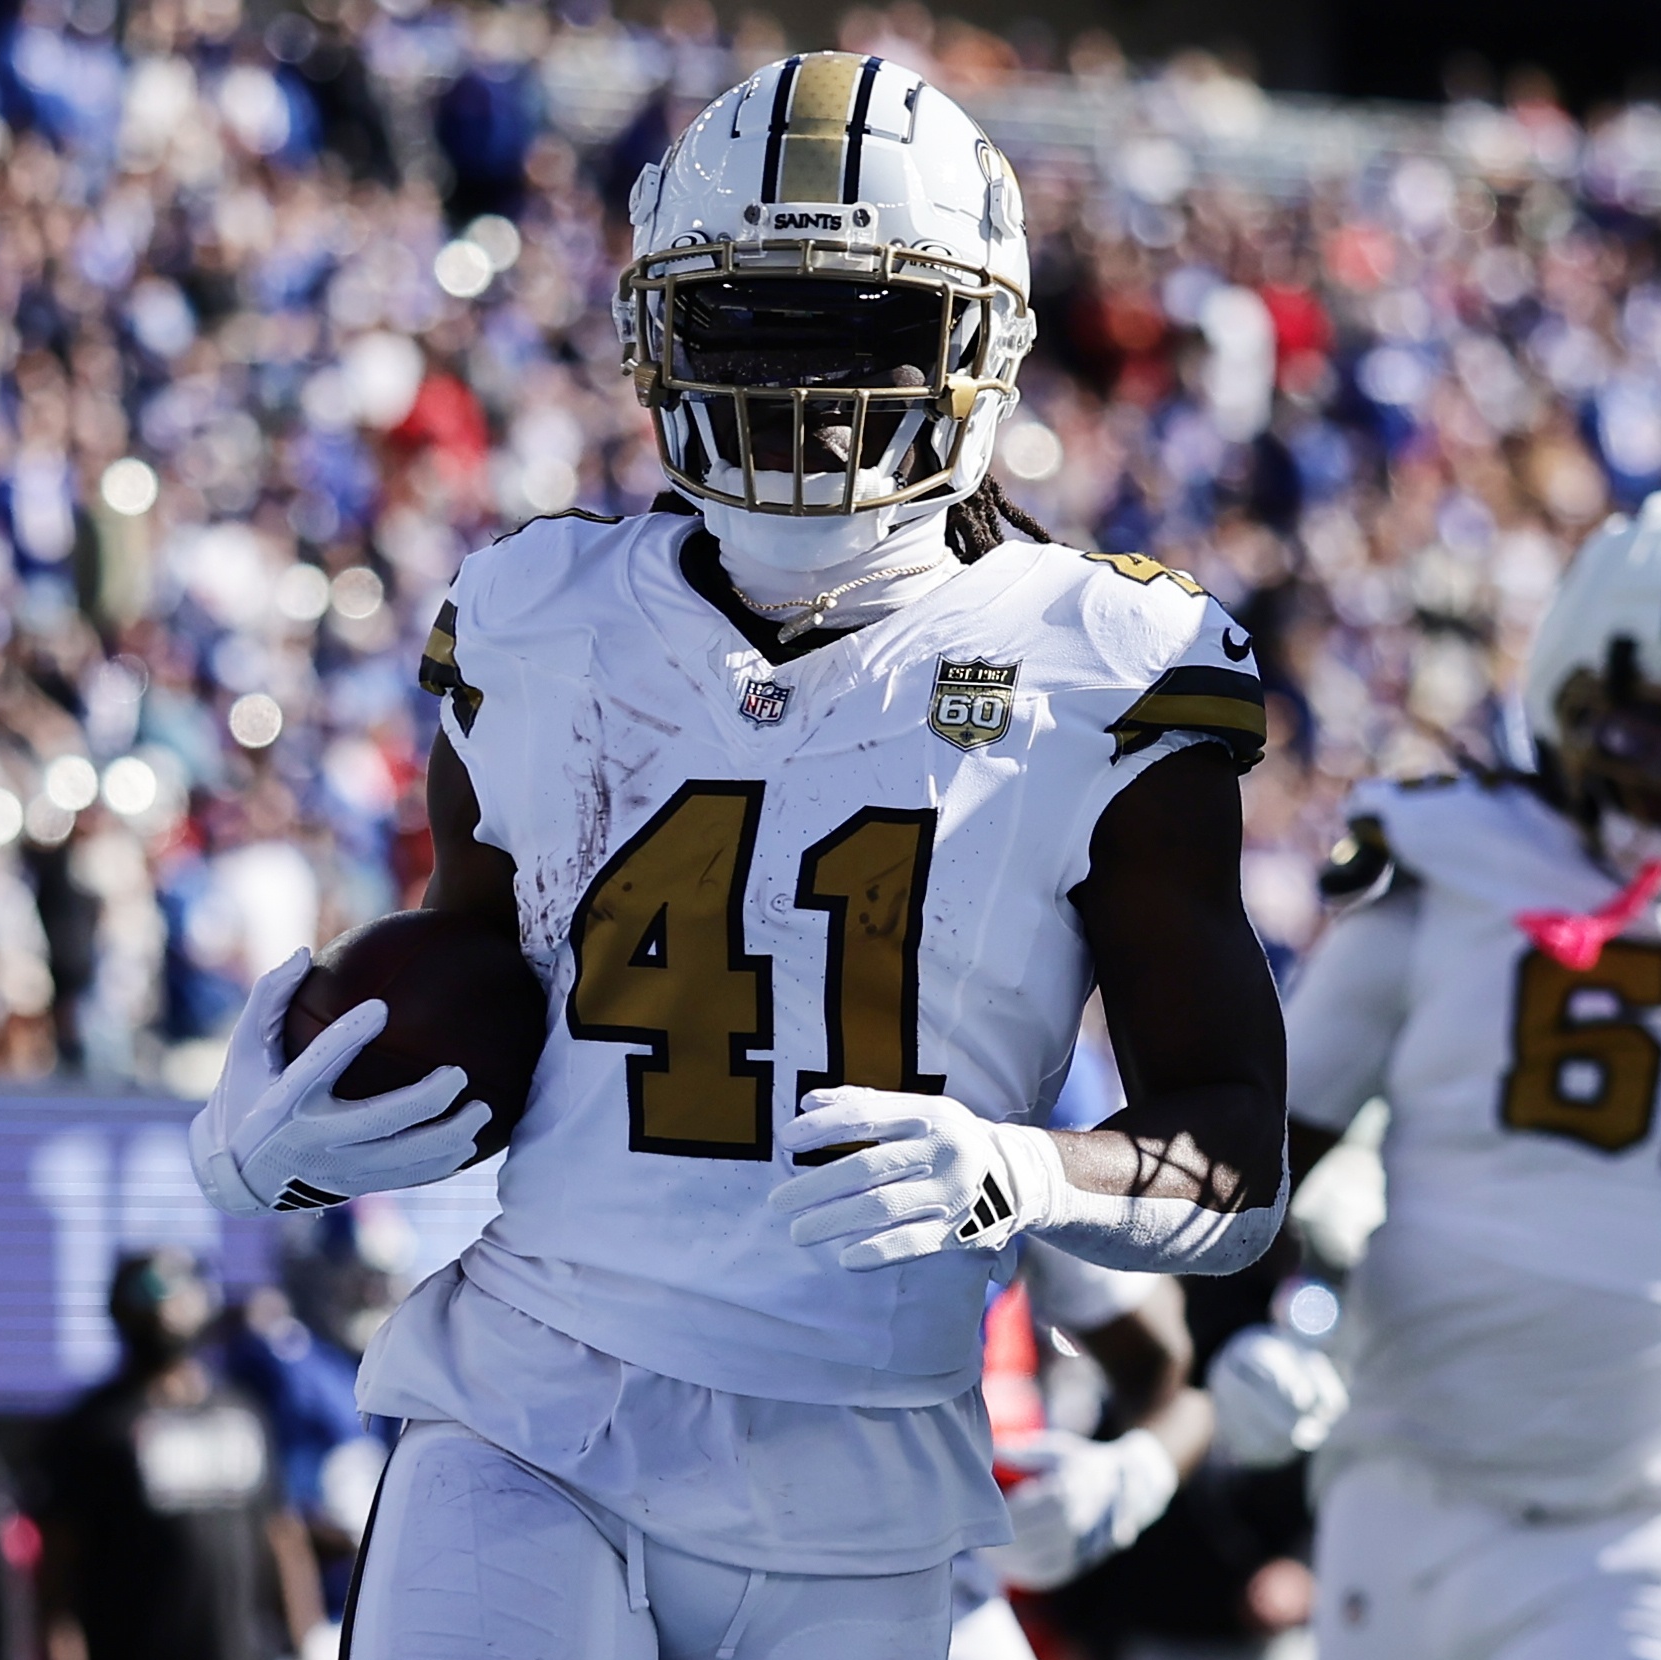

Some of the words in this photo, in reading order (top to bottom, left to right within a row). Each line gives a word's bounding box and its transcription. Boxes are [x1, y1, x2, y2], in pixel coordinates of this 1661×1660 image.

[774, 213, 842, 231] SAINTS
[976, 668, 1009, 682] 1967
[744, 695, 779, 719] NFL
[938, 694, 1004, 730] 60
[566, 778, 946, 1167] 41
